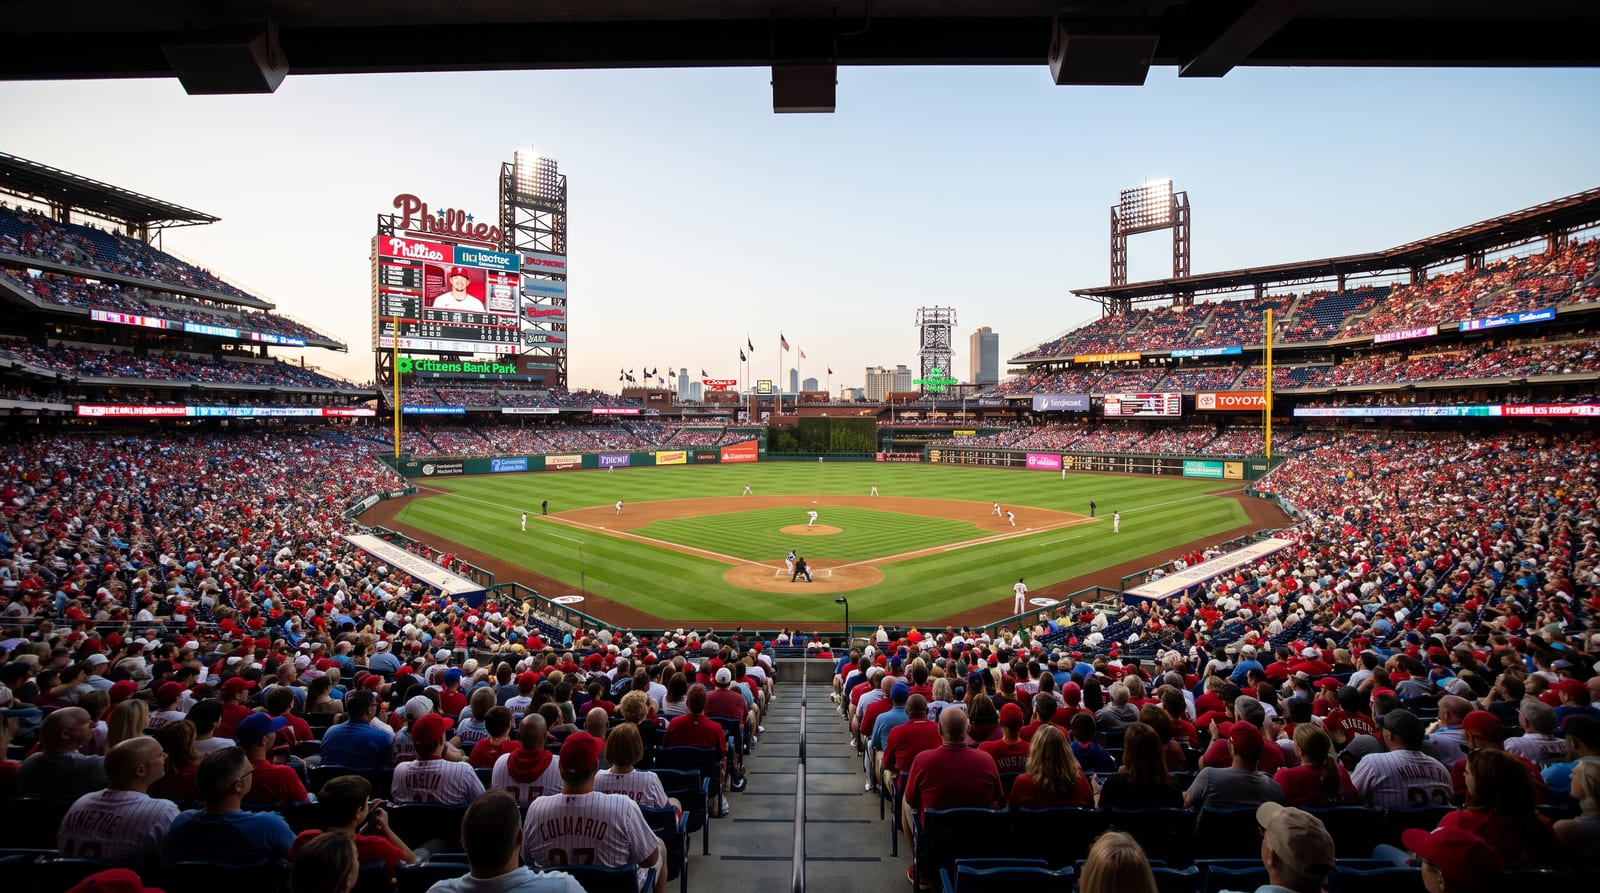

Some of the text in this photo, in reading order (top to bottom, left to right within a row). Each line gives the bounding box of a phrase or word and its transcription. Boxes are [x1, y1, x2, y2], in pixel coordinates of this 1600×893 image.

[393, 193, 503, 243] Phillies
[389, 240, 443, 261] Phillies
[415, 359, 517, 374] Citizens Bank Park
[1218, 396, 1267, 406] TOYOTA
[539, 816, 608, 842] CULMARIO
